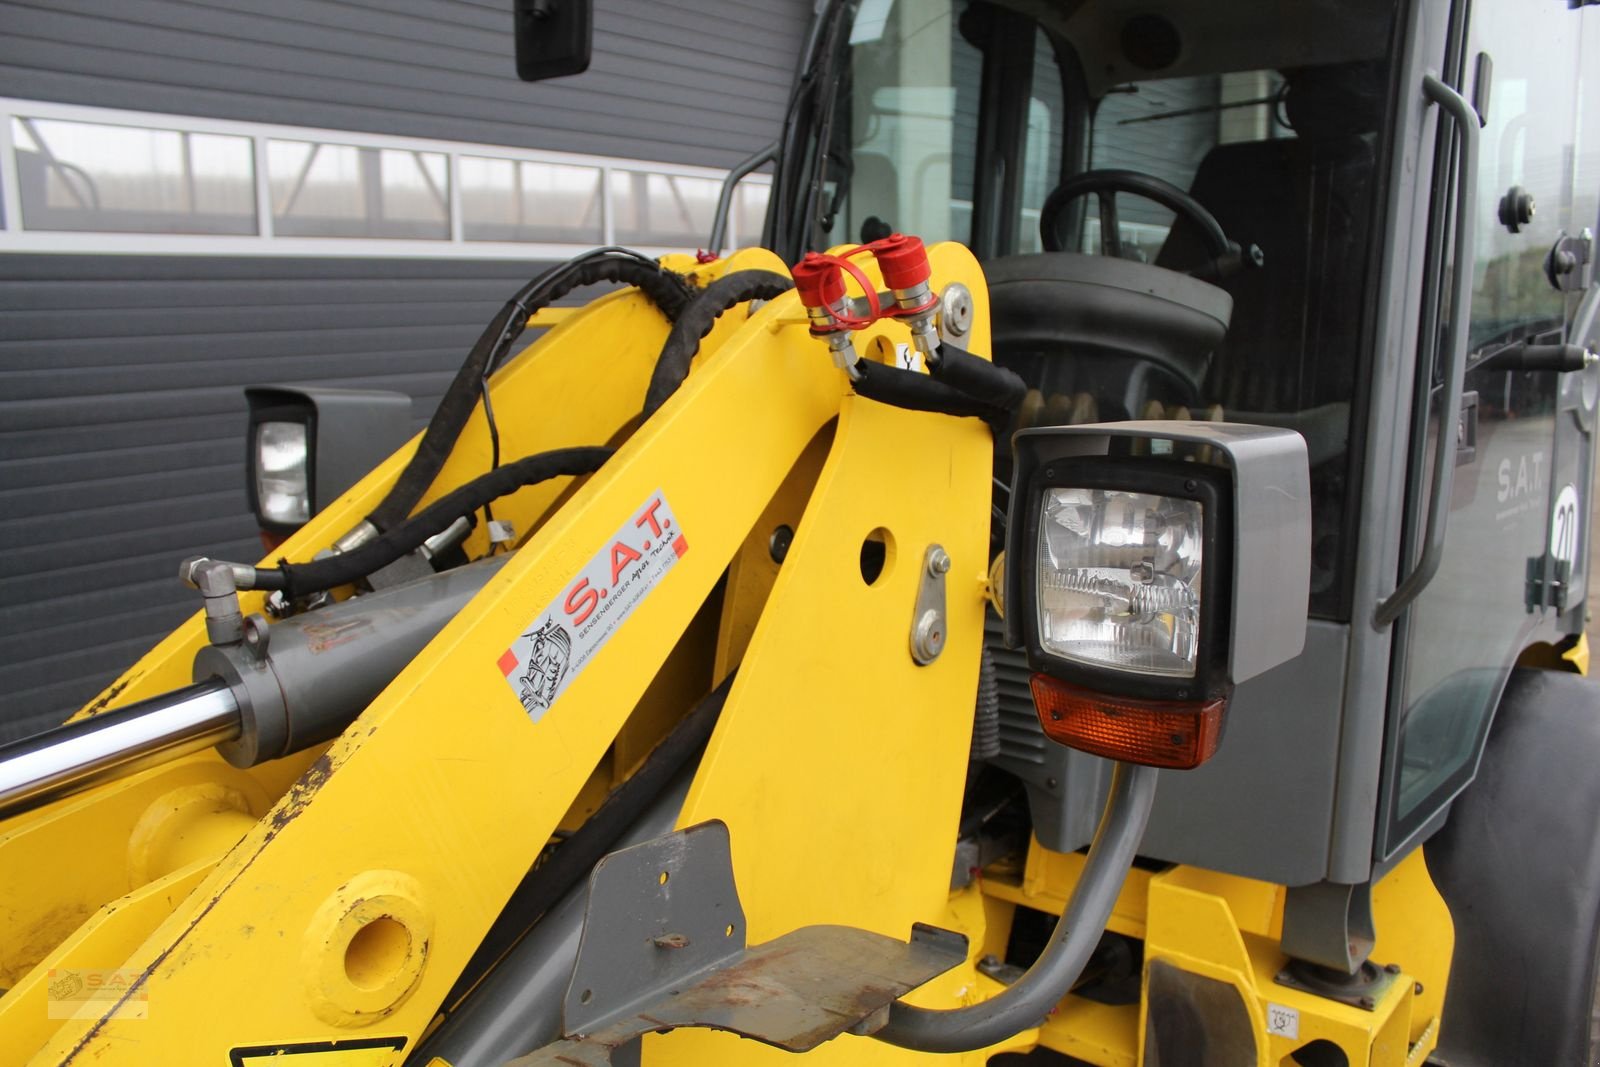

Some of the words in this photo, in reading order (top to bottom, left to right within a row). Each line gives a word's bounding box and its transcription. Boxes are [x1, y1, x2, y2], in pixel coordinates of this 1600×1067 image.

[1497, 451, 1543, 503] S.A.T.
[564, 498, 671, 628] S.A.T.
[578, 579, 630, 640] SENSENBERGER
